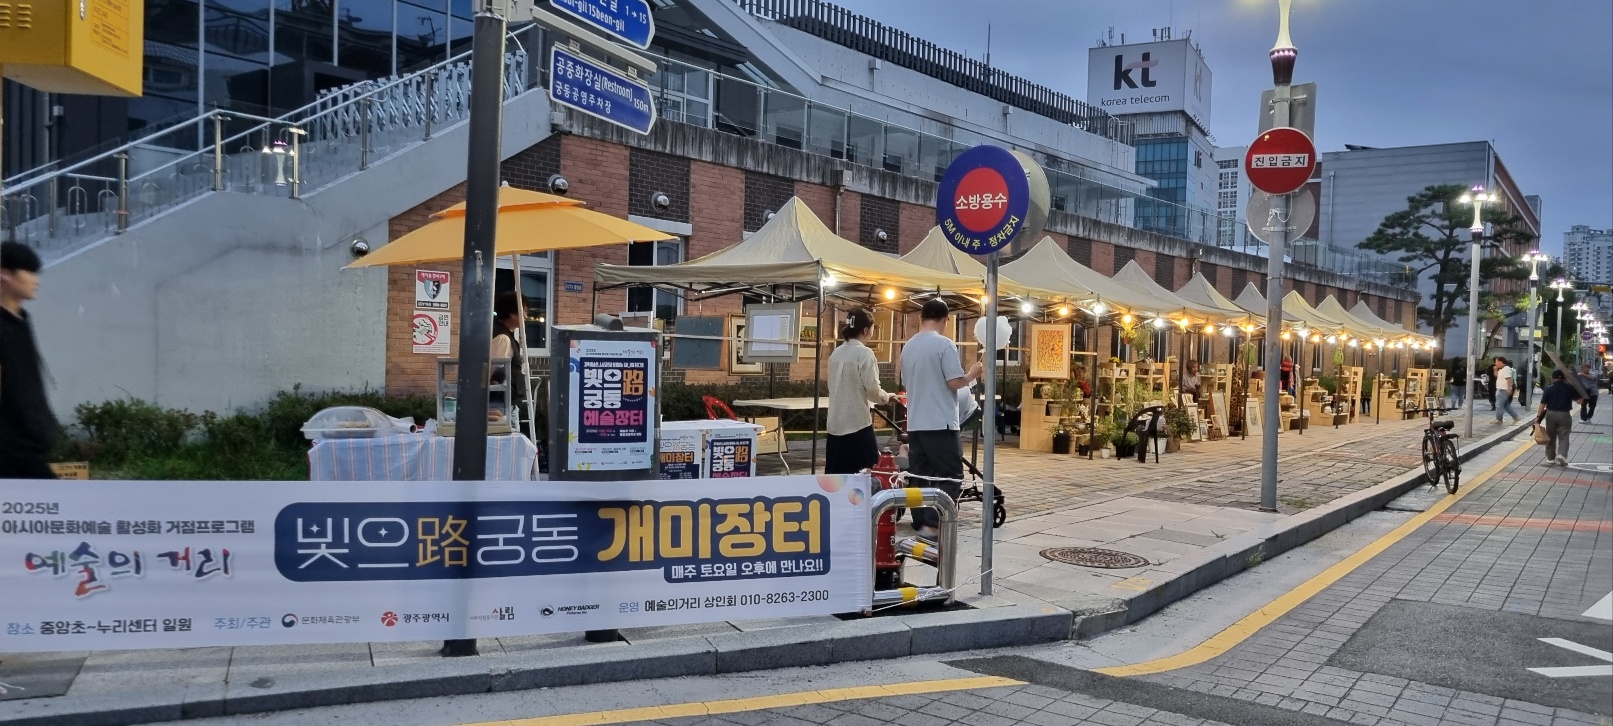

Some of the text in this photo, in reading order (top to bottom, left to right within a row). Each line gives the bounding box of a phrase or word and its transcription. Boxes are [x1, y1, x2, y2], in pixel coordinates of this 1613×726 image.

[639, 12, 647, 24] 15
[1113, 51, 1159, 91] kt
[555, 81, 612, 114] 궁동공영주차장
[634, 98, 649, 113] 150m
[1101, 95, 1170, 107] korea telecom
[1254, 155, 1306, 167] 진입금지
[955, 193, 1008, 210] 소방용수
[944, 218, 956, 234] 5M
[954, 232, 971, 249] 이내
[583, 389, 622, 409] 궁동
[583, 410, 644, 426] 예술장터
[2, 502, 59, 515] 2025년
[2, 520, 256, 535] 아시아문화예술 활성화 거점프로그램
[596, 501, 822, 560] 개미장터
[25, 541, 231, 597] 예술의 거리
[671, 559, 824, 580] 매주 토요일 오후에 만나요!!
[618, 589, 829, 613] 운영 예술의거리 상인회 010-8263-2300
[301, 615, 360, 625] 문화체육관광부
[403, 612, 450, 624] 광주광역시
[493, 606, 515, 621] 살림
[7, 618, 192, 635] 장소 중앙초~누리센터 일원
[214, 616, 272, 630] 주최/주관
